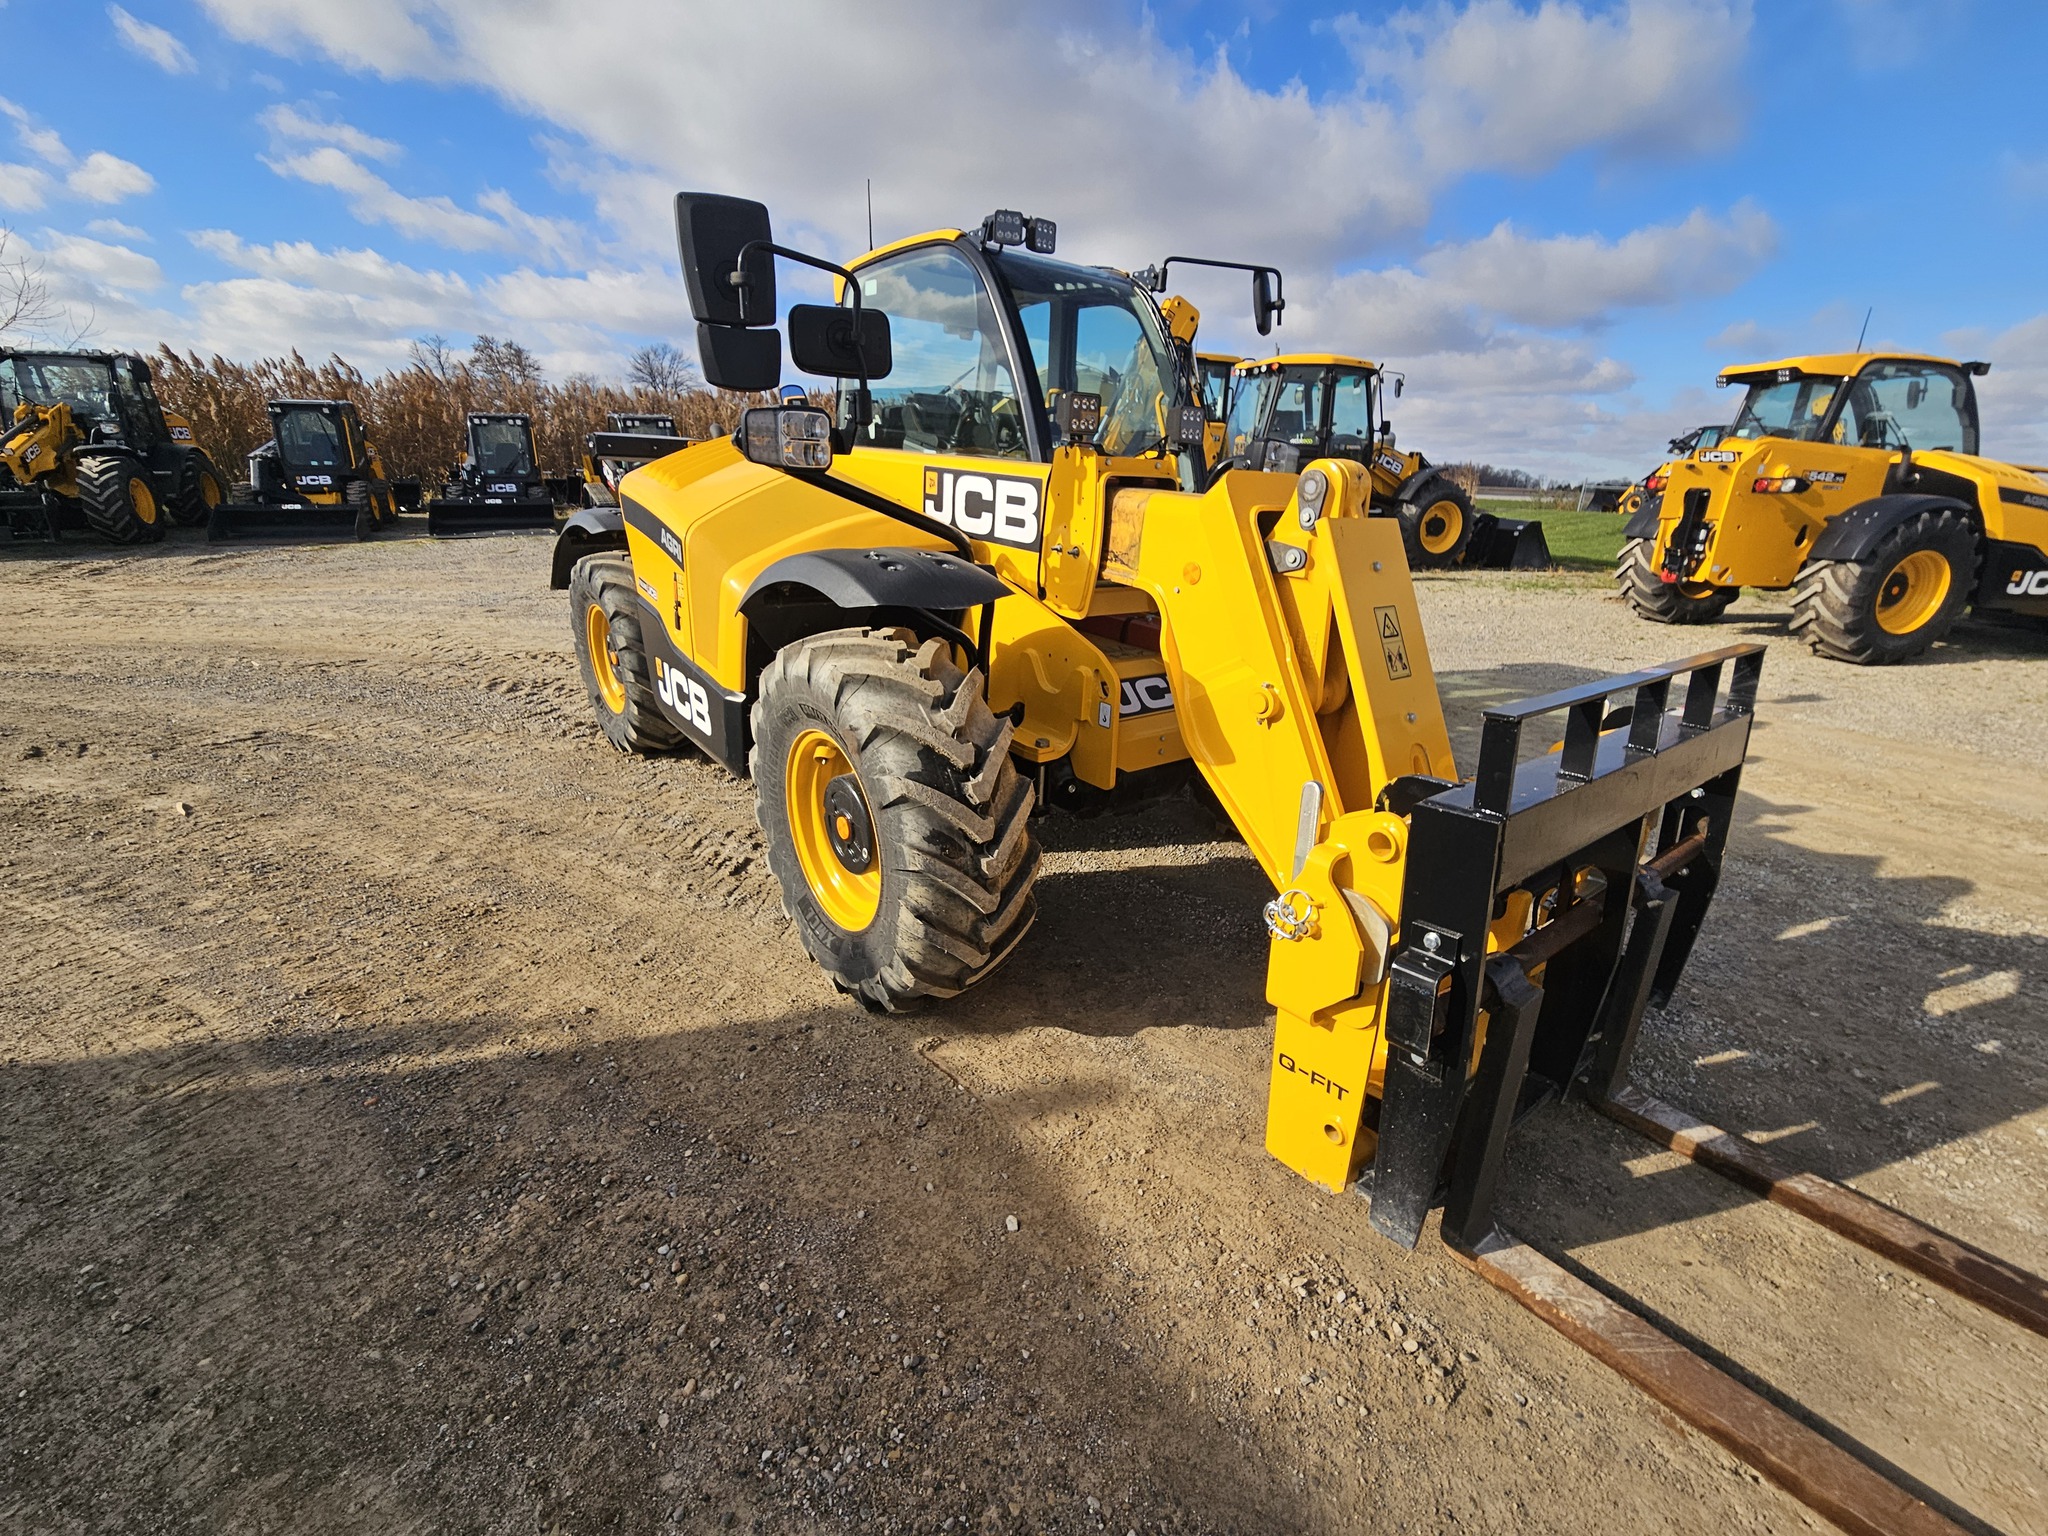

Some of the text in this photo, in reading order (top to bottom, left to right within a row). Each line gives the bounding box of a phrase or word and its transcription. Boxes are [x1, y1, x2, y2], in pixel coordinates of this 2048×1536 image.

[170, 426, 193, 440] JCB
[24, 442, 42, 464] JCB
[1700, 451, 1735, 463] JCB
[296, 475, 333, 486] JCB
[486, 483, 518, 493] JCB
[924, 471, 1039, 544] JCB
[661, 527, 683, 563] AGRI
[656, 657, 713, 737] JCB
[1278, 1052, 1350, 1101] Q-FIT
